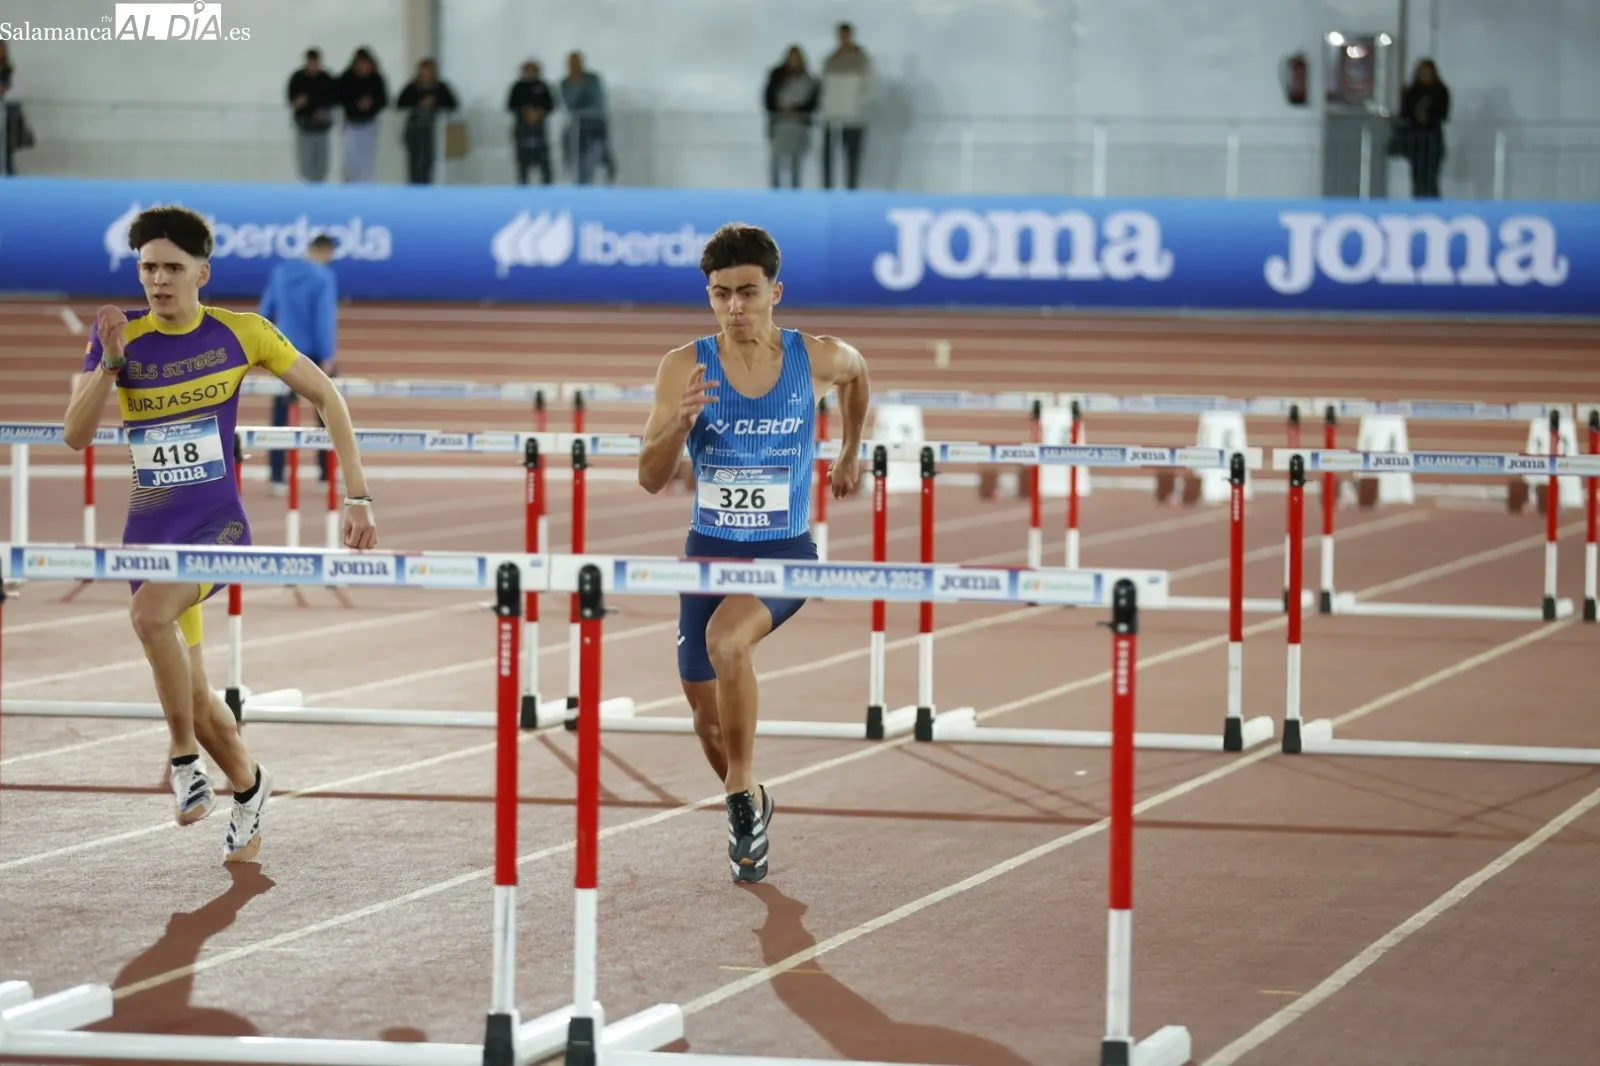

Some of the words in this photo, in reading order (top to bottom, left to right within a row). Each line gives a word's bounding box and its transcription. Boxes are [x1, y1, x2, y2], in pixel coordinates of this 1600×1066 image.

[205, 214, 393, 261] berdrola
[128, 360, 158, 380] ELS
[162, 347, 227, 378] SITGES
[127, 381, 229, 412] BURJASSOT
[152, 442, 199, 467] 418
[152, 466, 208, 486] Joma
[719, 487, 766, 509] 326
[714, 511, 770, 527] Joma
[111, 555, 171, 571] Joma
[186, 555, 278, 575] SALAMANCA
[280, 556, 315, 575] 2025
[329, 559, 389, 577] Joma
[791, 567, 889, 588] SALAMANCA
[890, 571, 925, 590] 2025
